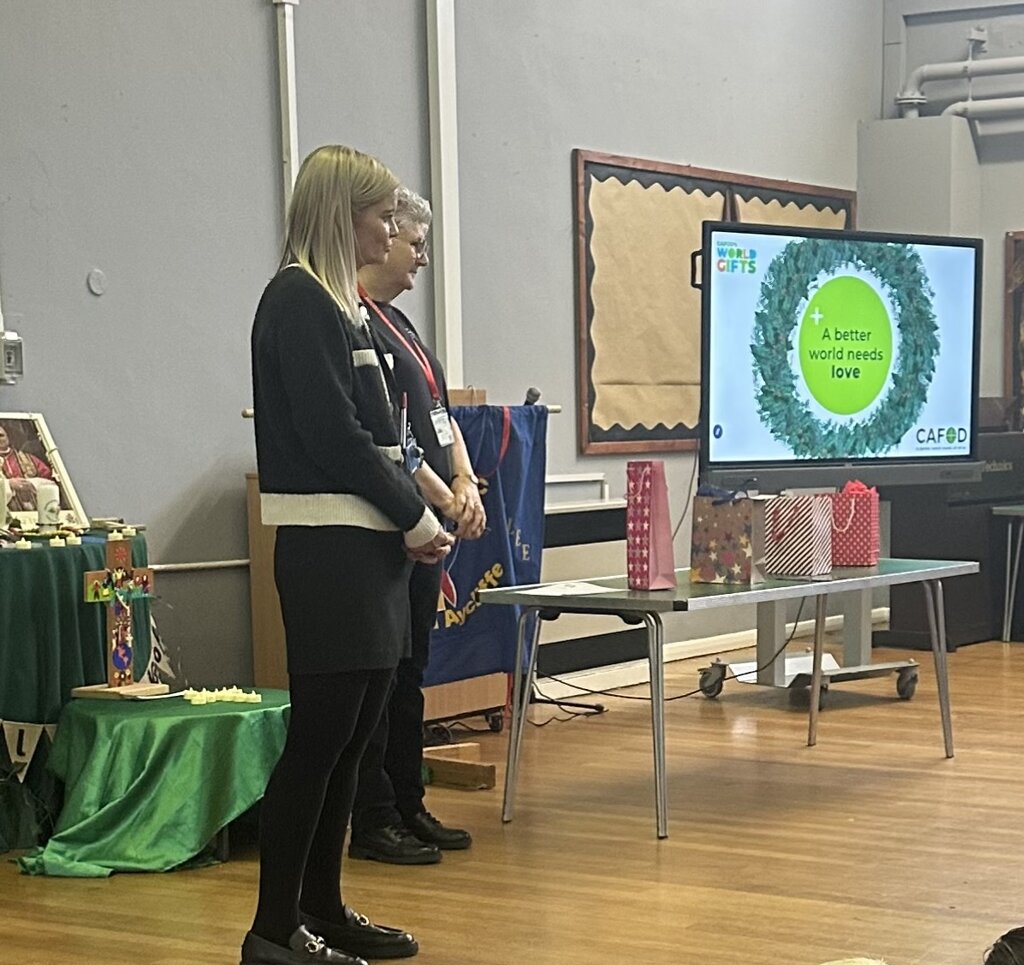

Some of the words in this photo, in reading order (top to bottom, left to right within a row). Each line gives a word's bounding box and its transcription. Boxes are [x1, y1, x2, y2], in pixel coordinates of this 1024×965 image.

[717, 247, 757, 260] WORLD
[717, 259, 757, 274] GIFTS
[822, 328, 832, 341] A
[834, 329, 872, 342] better
[808, 346, 844, 361] world
[847, 347, 884, 361] needs
[831, 365, 861, 379] love
[916, 427, 968, 444] CAFOD
